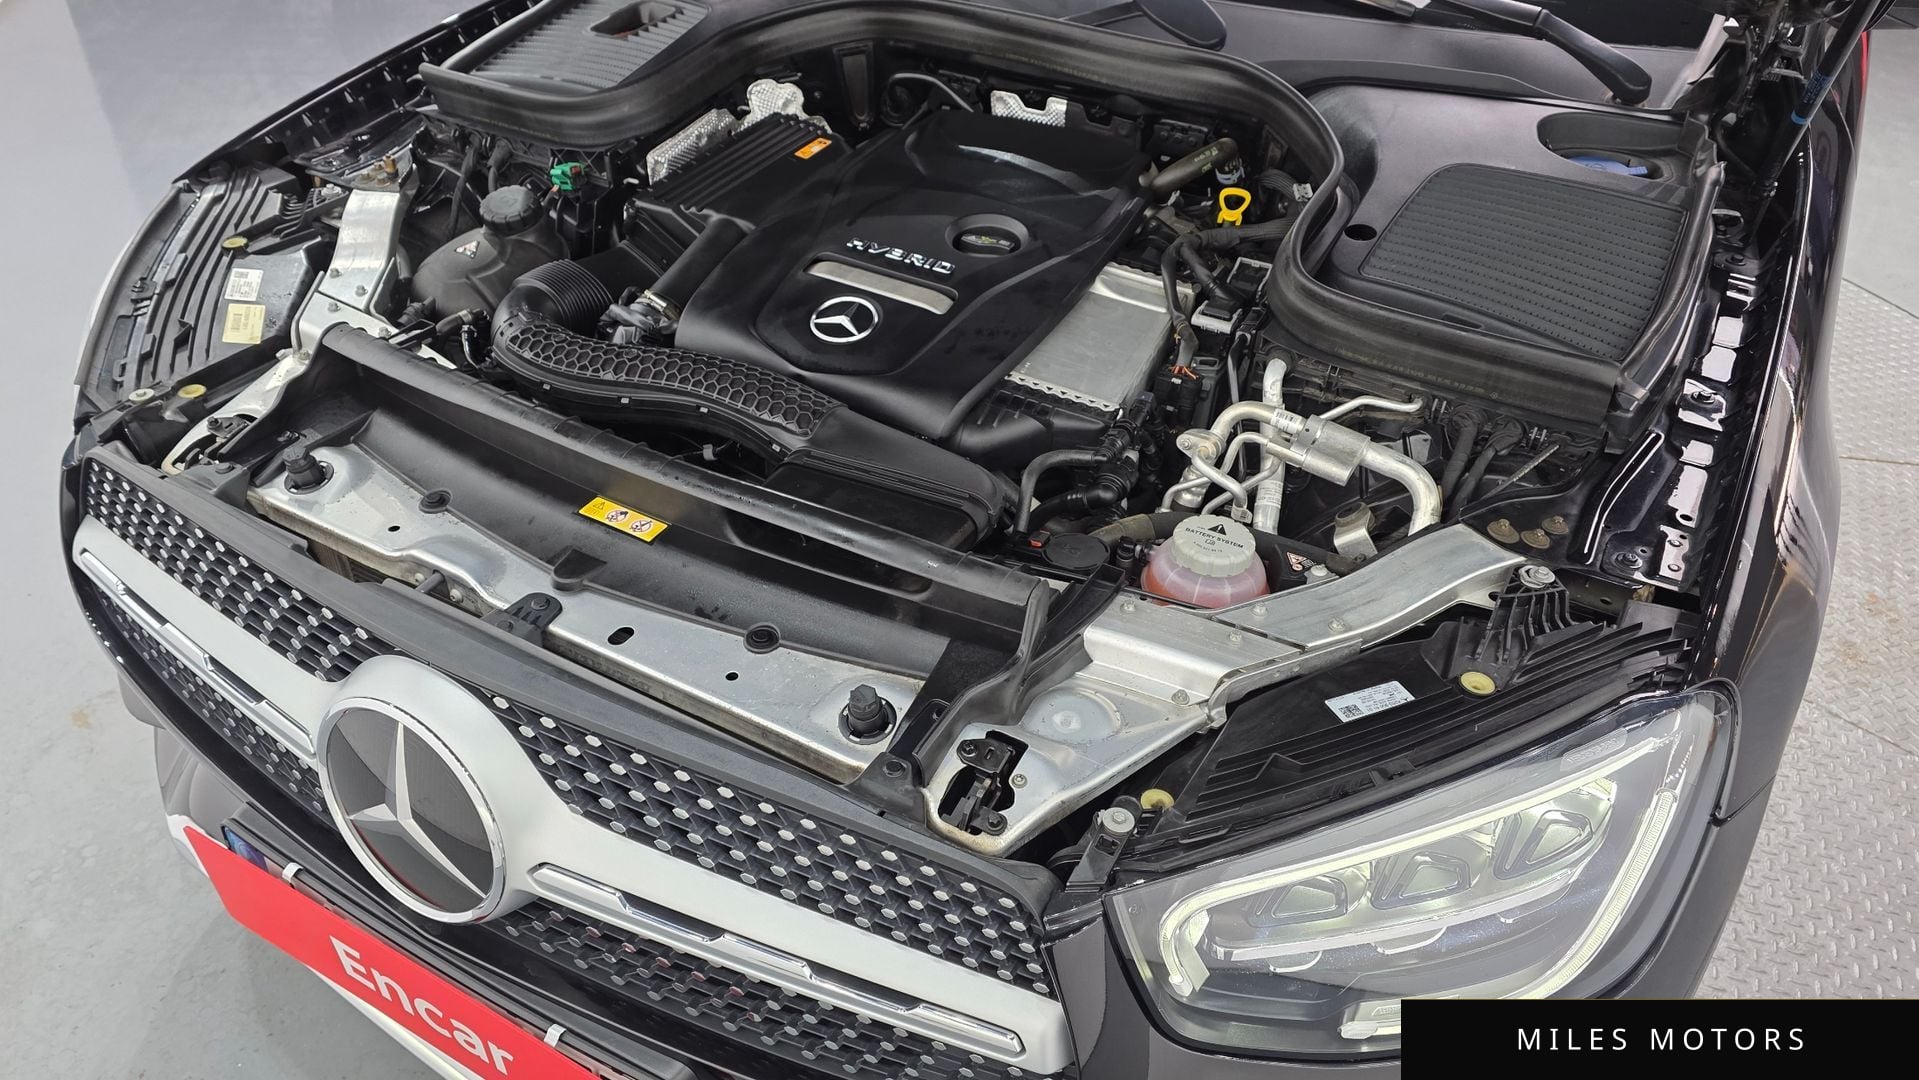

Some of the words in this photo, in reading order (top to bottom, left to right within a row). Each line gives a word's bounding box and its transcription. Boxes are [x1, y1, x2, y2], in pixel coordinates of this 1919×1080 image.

[846, 238, 955, 274] HYBRID
[1185, 527, 1215, 539] BATTERY
[1217, 536, 1244, 549] SYSTEM
[329, 935, 514, 1076] Encar
